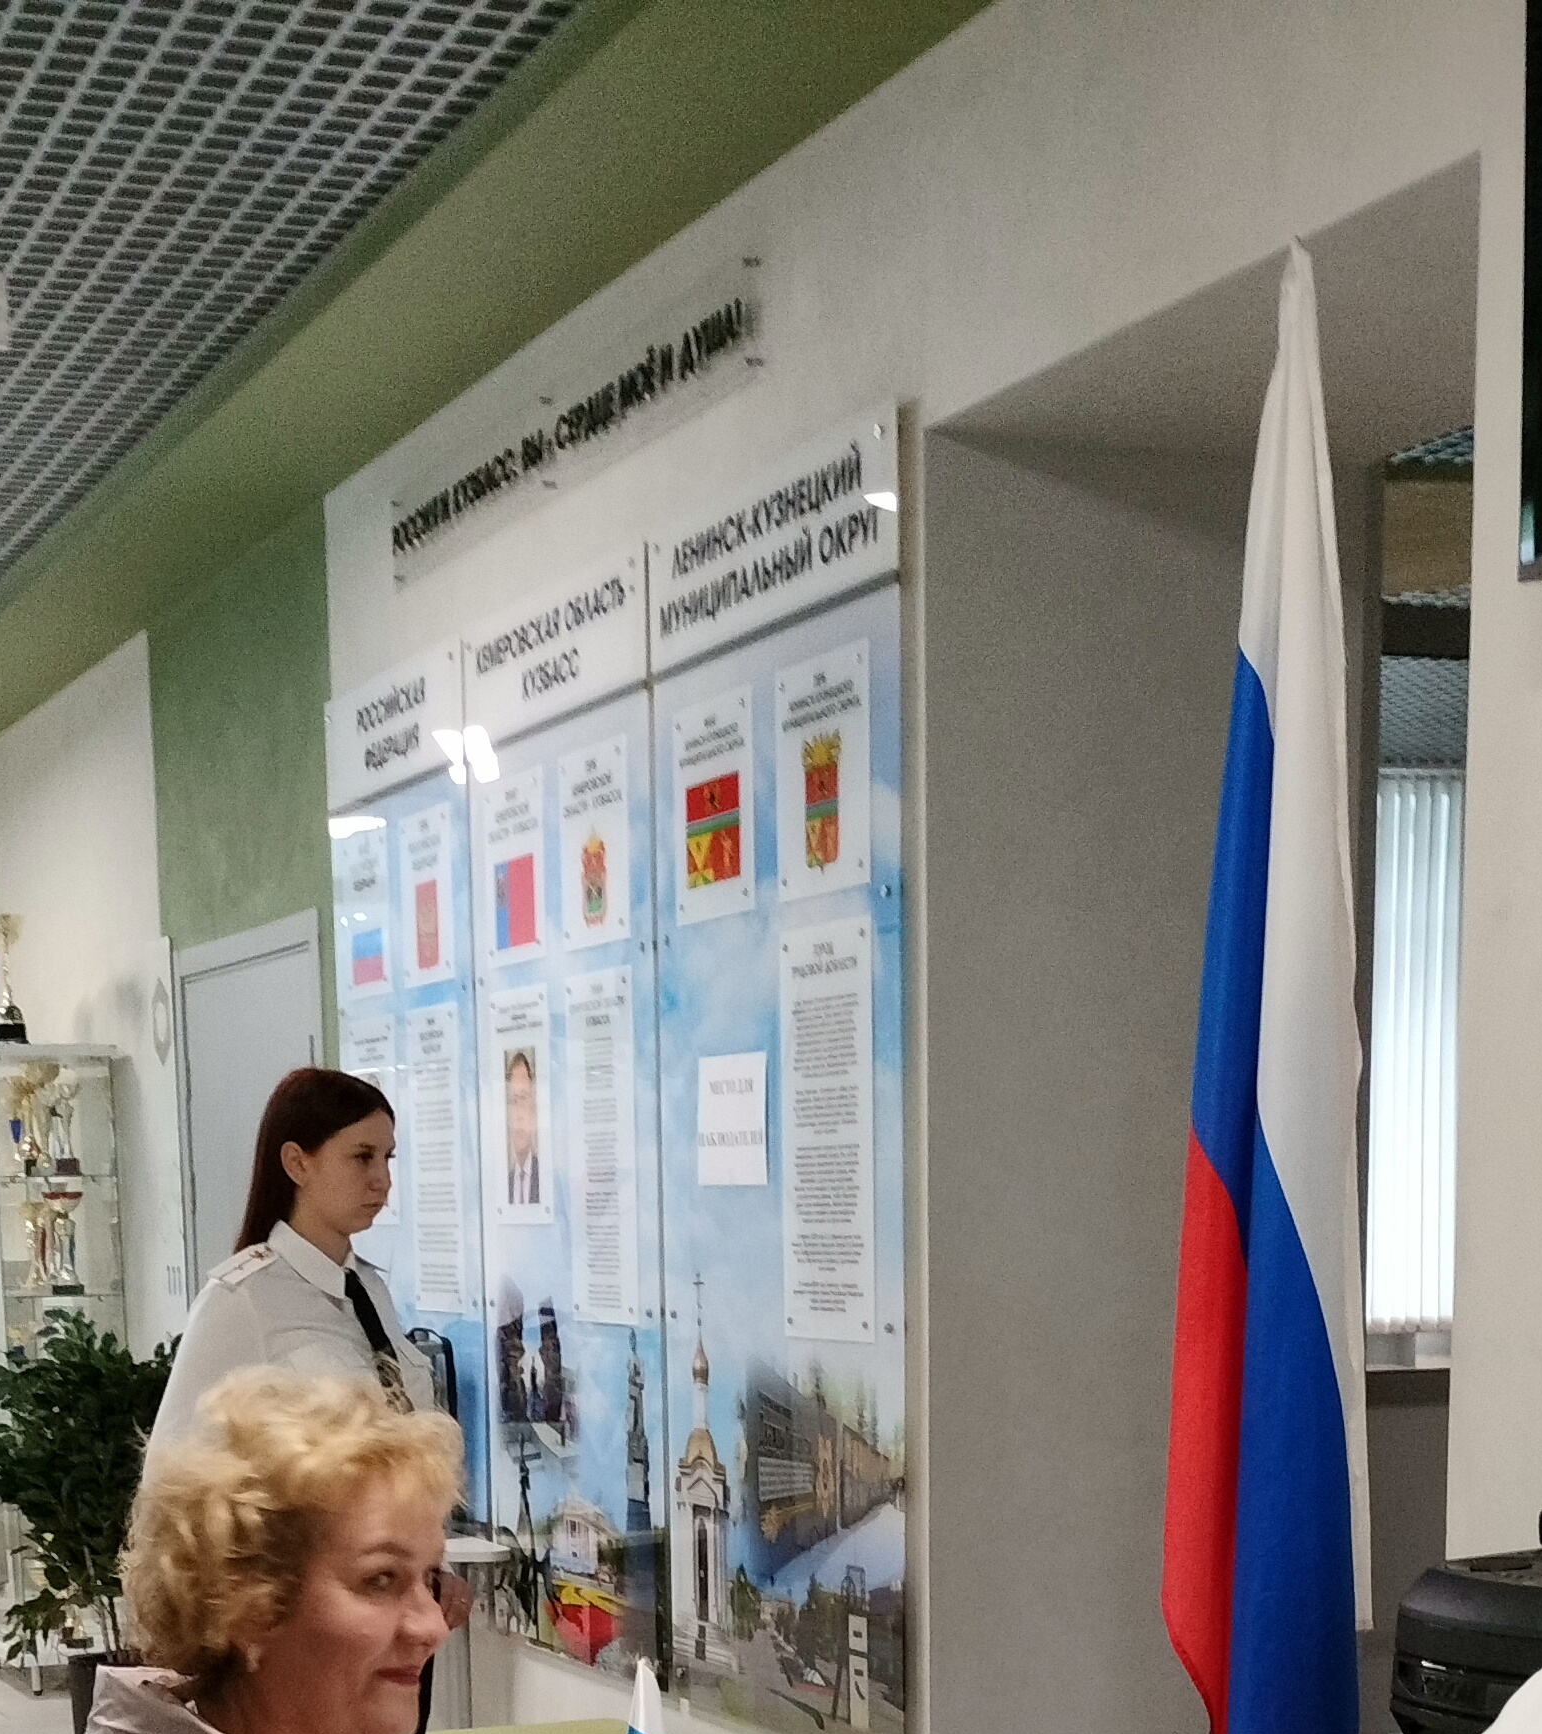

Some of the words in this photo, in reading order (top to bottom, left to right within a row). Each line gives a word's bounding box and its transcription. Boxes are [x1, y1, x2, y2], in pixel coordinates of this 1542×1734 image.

[659, 523, 813, 639] МУНИЦИПАЛЬНЫЙ
[819, 503, 879, 567] ОКРУГ
[671, 438, 863, 580] ЛЕНИНСК-КУЗНЕЦКИЙ
